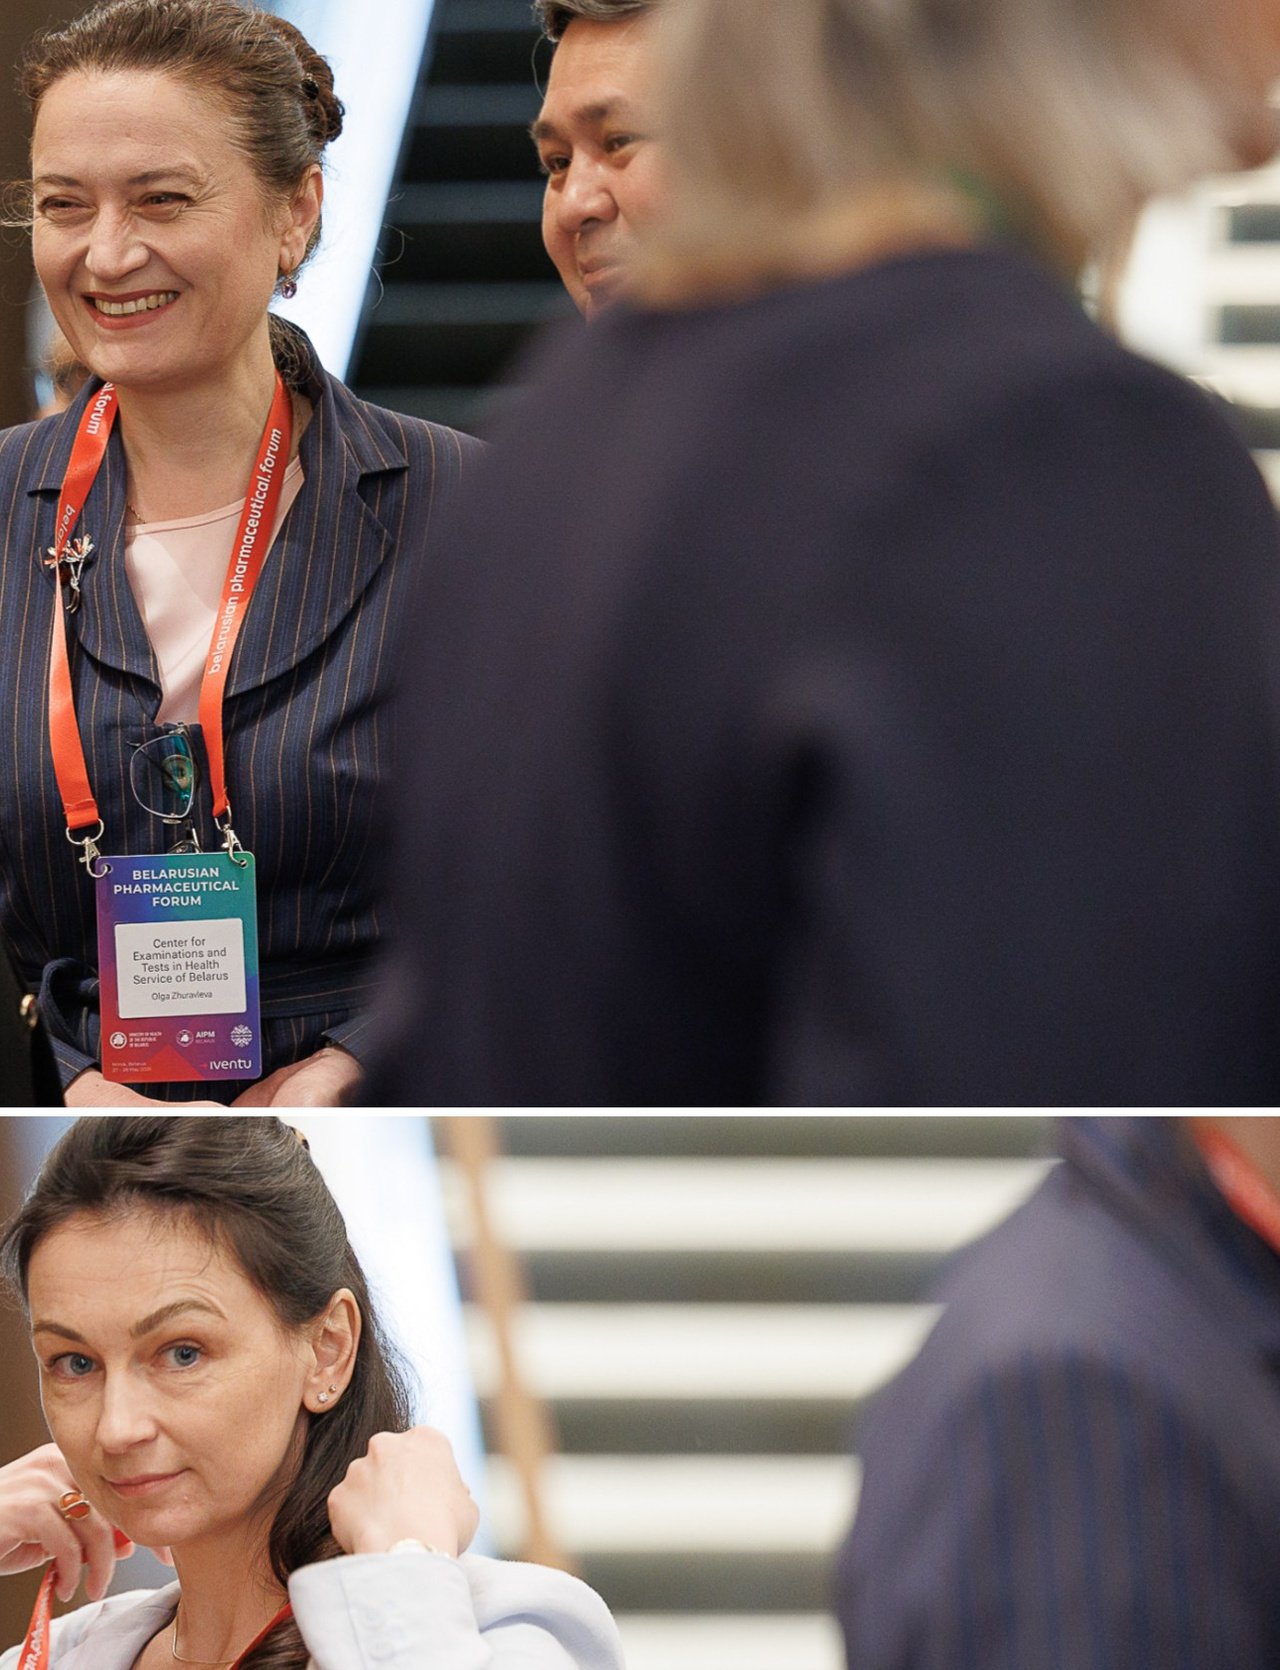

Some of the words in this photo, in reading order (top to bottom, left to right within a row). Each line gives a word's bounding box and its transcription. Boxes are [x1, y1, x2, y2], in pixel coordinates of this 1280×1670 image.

[208, 595, 239, 675] belarusian
[132, 867, 219, 880] BELARUSIAN
[114, 881, 240, 895] PHARMACEUTICAL
[152, 896, 202, 907] FORUM
[153, 938, 188, 949] Center
[191, 936, 206, 947] for
[133, 949, 205, 961] Examinations
[207, 948, 227, 959] and
[141, 962, 170, 973] Tests
[173, 961, 183, 971] in
[185, 959, 220, 970] Health
[133, 973, 172, 985] Service
[175, 972, 187, 983] of
[189, 971, 229, 982] Belarus
[151, 992, 171, 1002] Olga
[196, 1031, 216, 1039] AIPM
